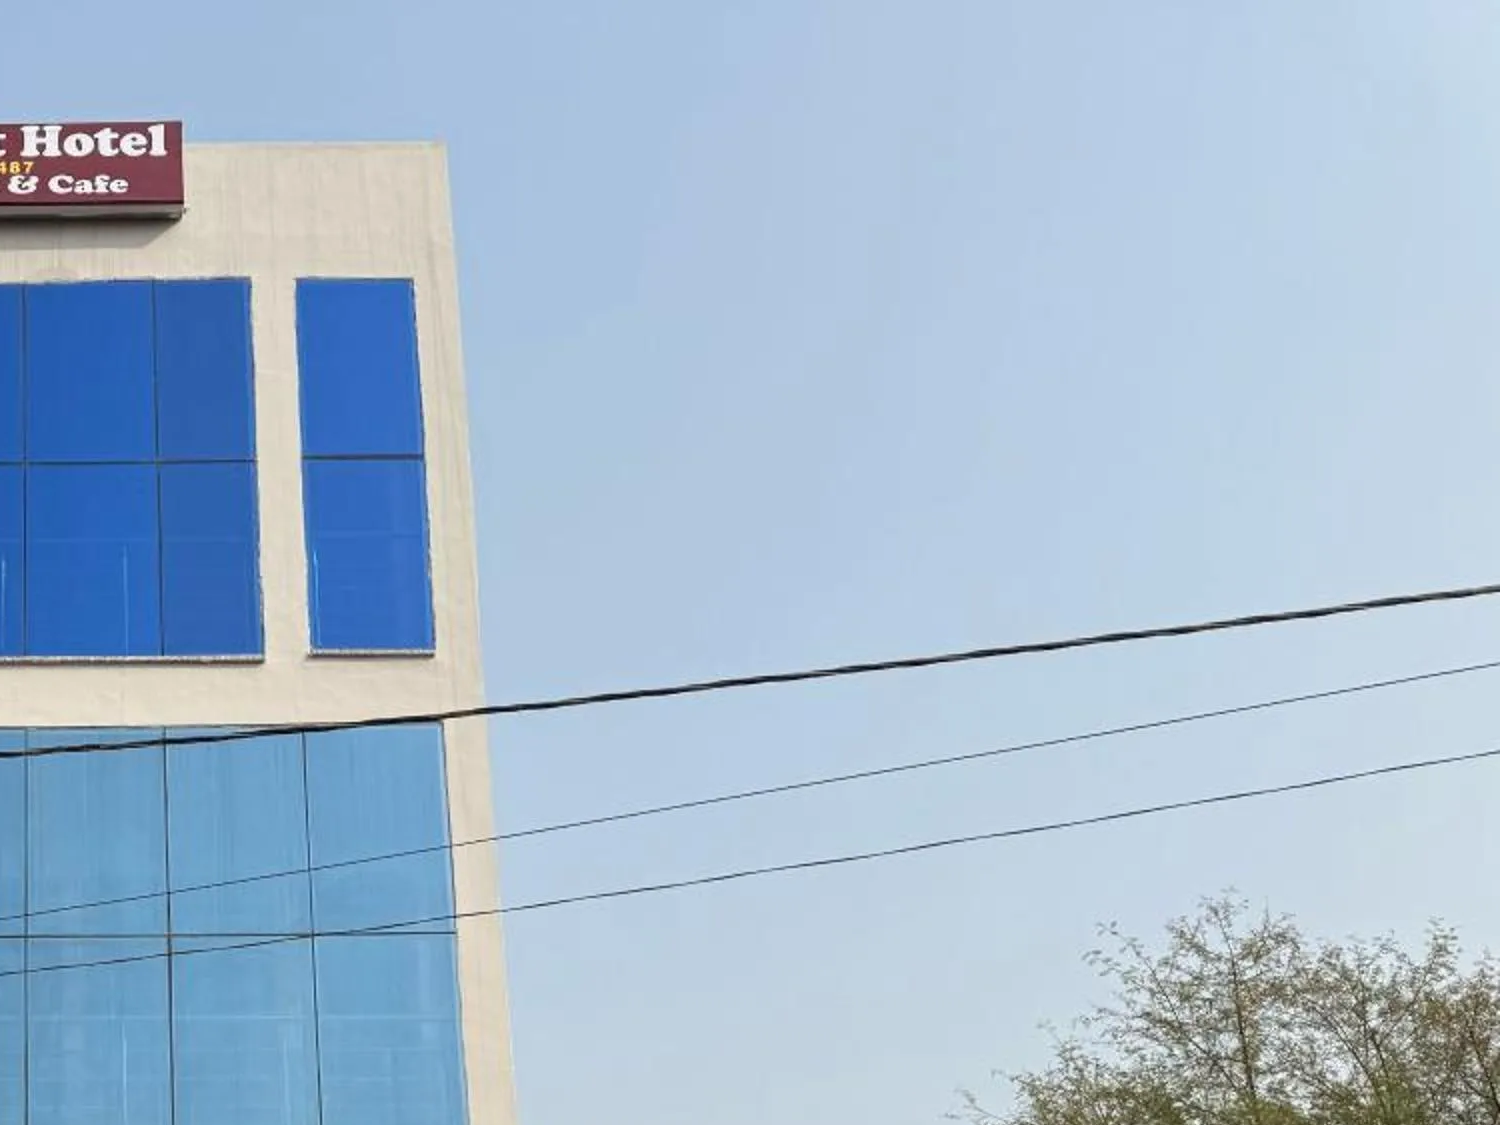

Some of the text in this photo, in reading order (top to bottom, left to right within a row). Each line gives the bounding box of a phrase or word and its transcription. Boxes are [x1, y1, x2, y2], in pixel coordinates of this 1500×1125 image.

[20, 124, 168, 158] Hotel
[7, 175, 39, 195] &
[49, 175, 129, 195] Cafe
